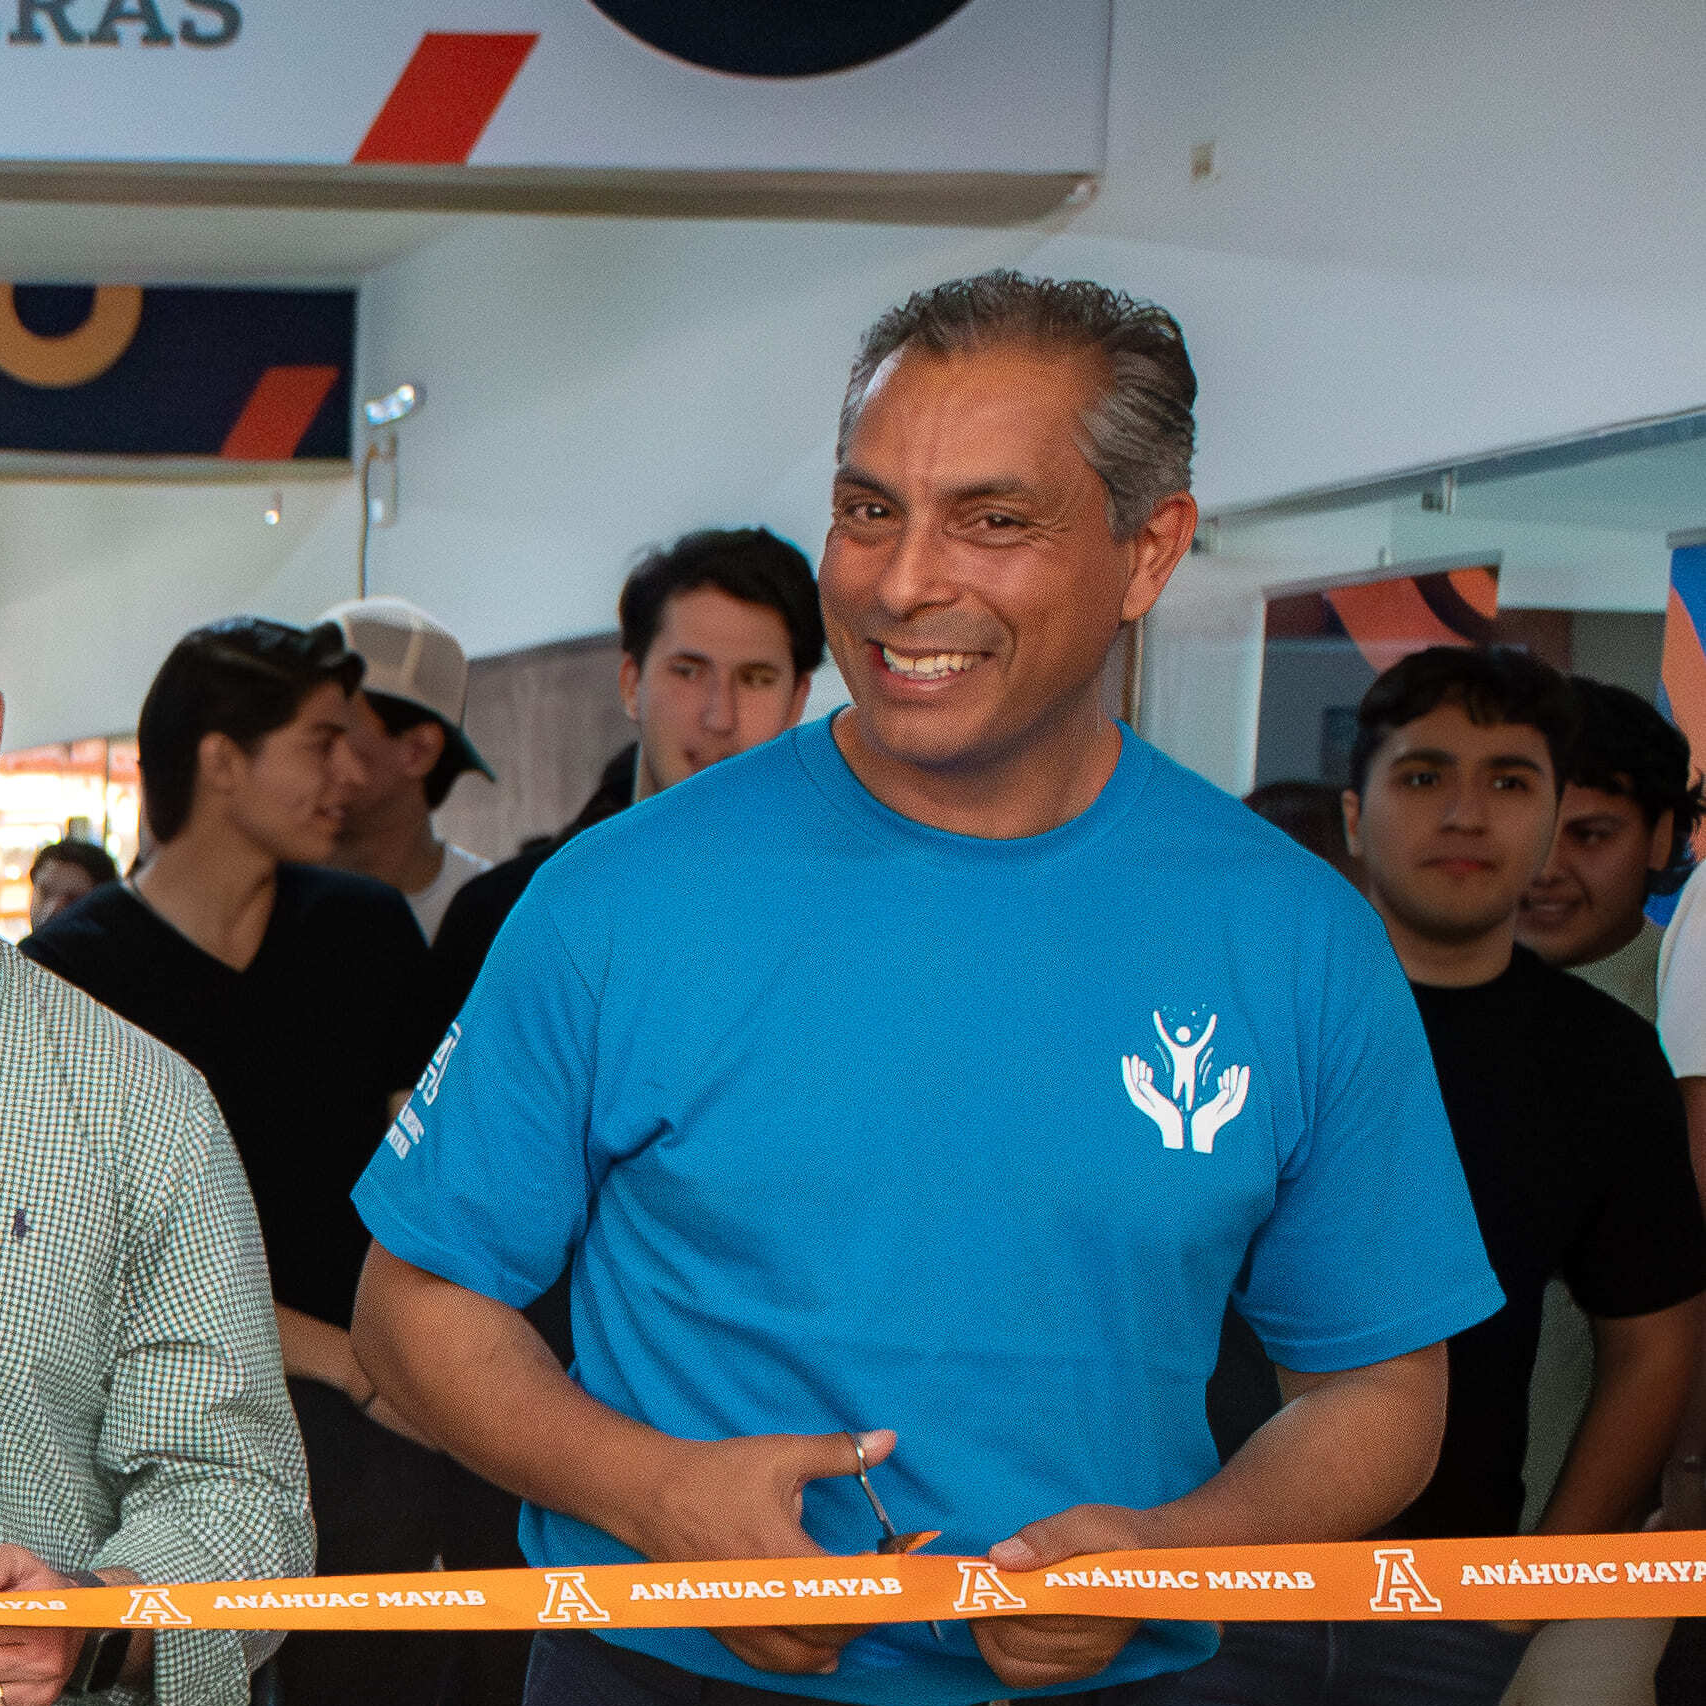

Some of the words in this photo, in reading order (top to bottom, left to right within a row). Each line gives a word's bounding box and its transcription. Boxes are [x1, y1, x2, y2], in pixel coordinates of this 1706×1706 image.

[120, 1588, 192, 1625] A
[213, 1591, 369, 1610] ANÁHUAC
[376, 1590, 486, 1608] MAYAB
[538, 1572, 610, 1623] A
[629, 1578, 786, 1601] ANÁHUAC
[793, 1577, 902, 1598] MAYAB
[952, 1561, 1027, 1612] A
[1045, 1567, 1200, 1589] ANÁHUAC
[1204, 1571, 1316, 1590] MAYAB
[1369, 1548, 1443, 1612] A
[1460, 1558, 1618, 1586] ANÁHUAC
